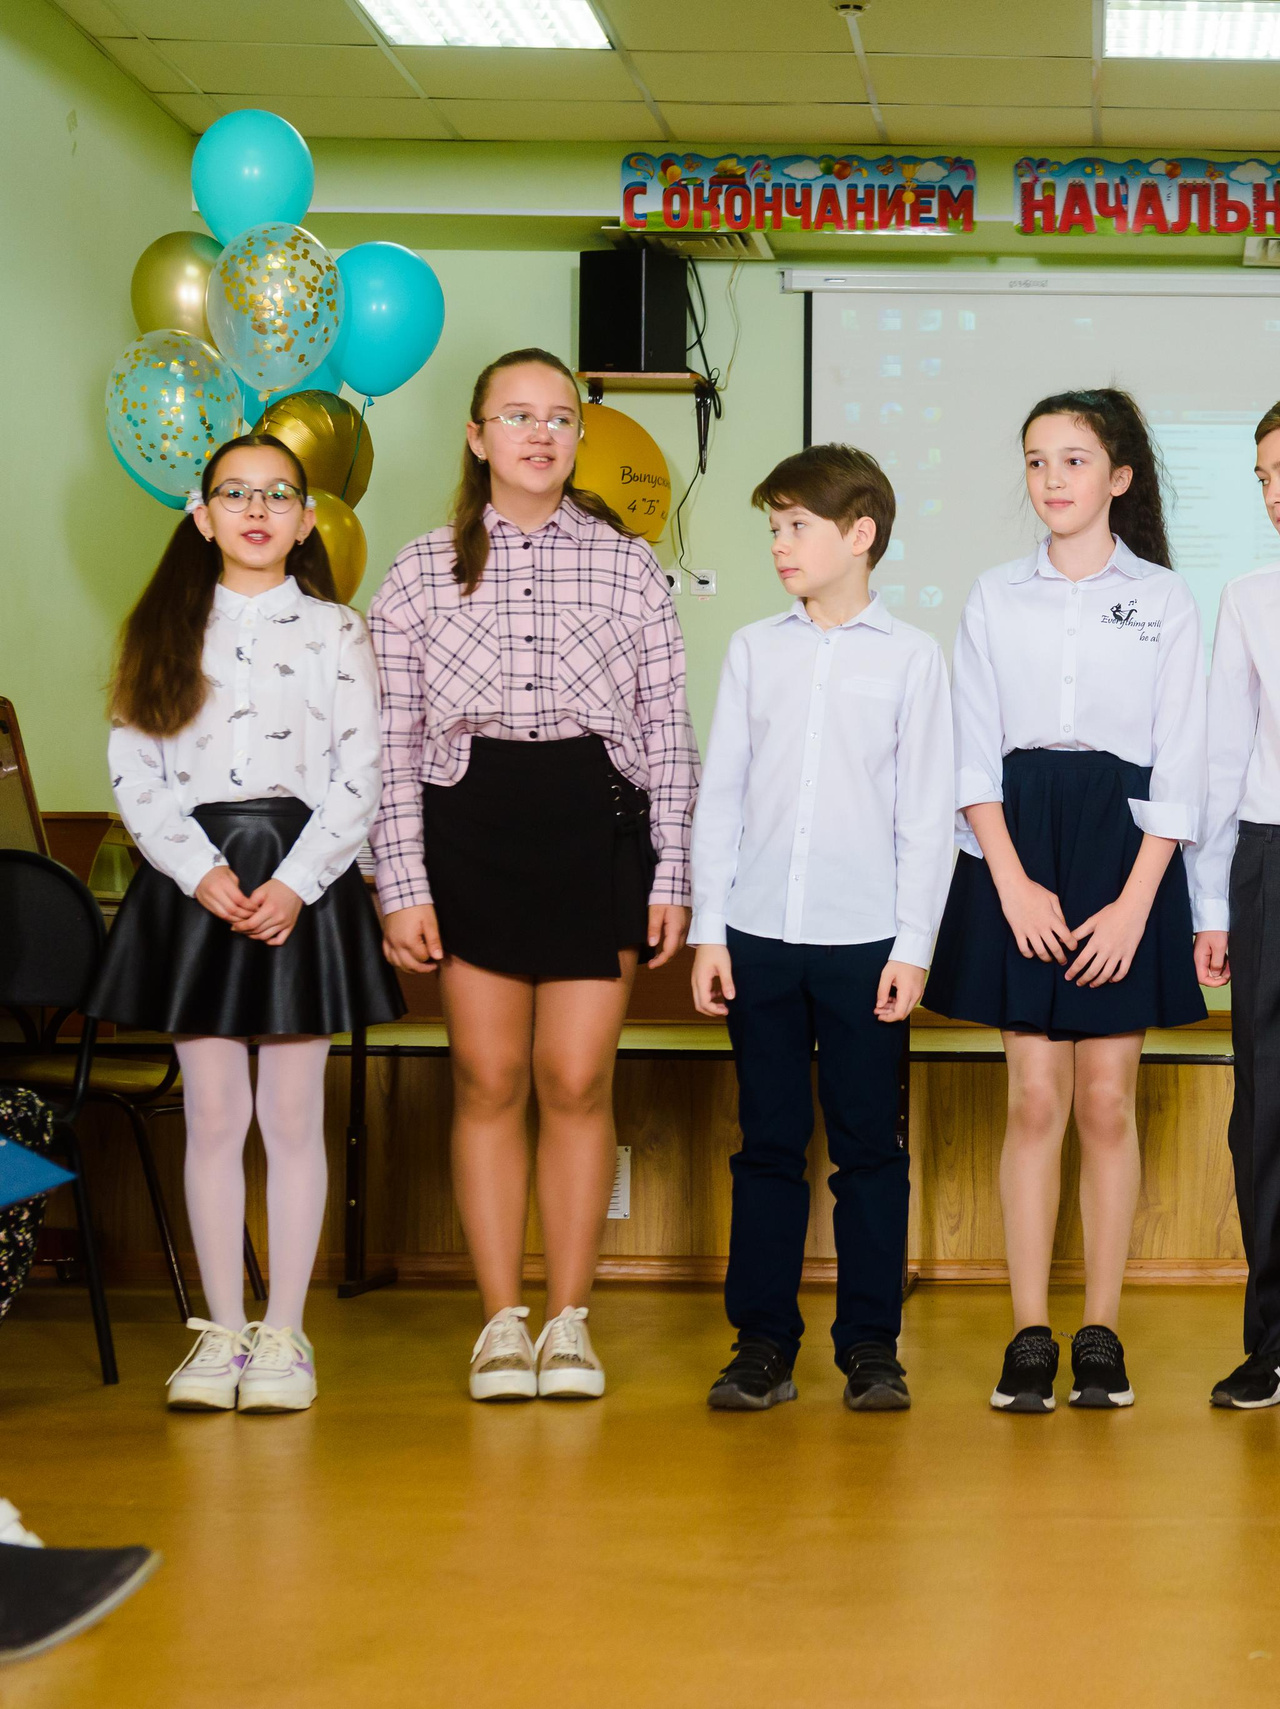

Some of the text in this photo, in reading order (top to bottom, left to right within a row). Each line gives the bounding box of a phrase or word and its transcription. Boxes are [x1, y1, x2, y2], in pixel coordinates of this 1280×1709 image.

[623, 183, 648, 229] С
[662, 183, 974, 232] ОКОНЧАНИЕМ
[627, 499, 637, 513] 4
[1100, 614, 1146, 631] Everything
[1139, 631, 1149, 641] be
